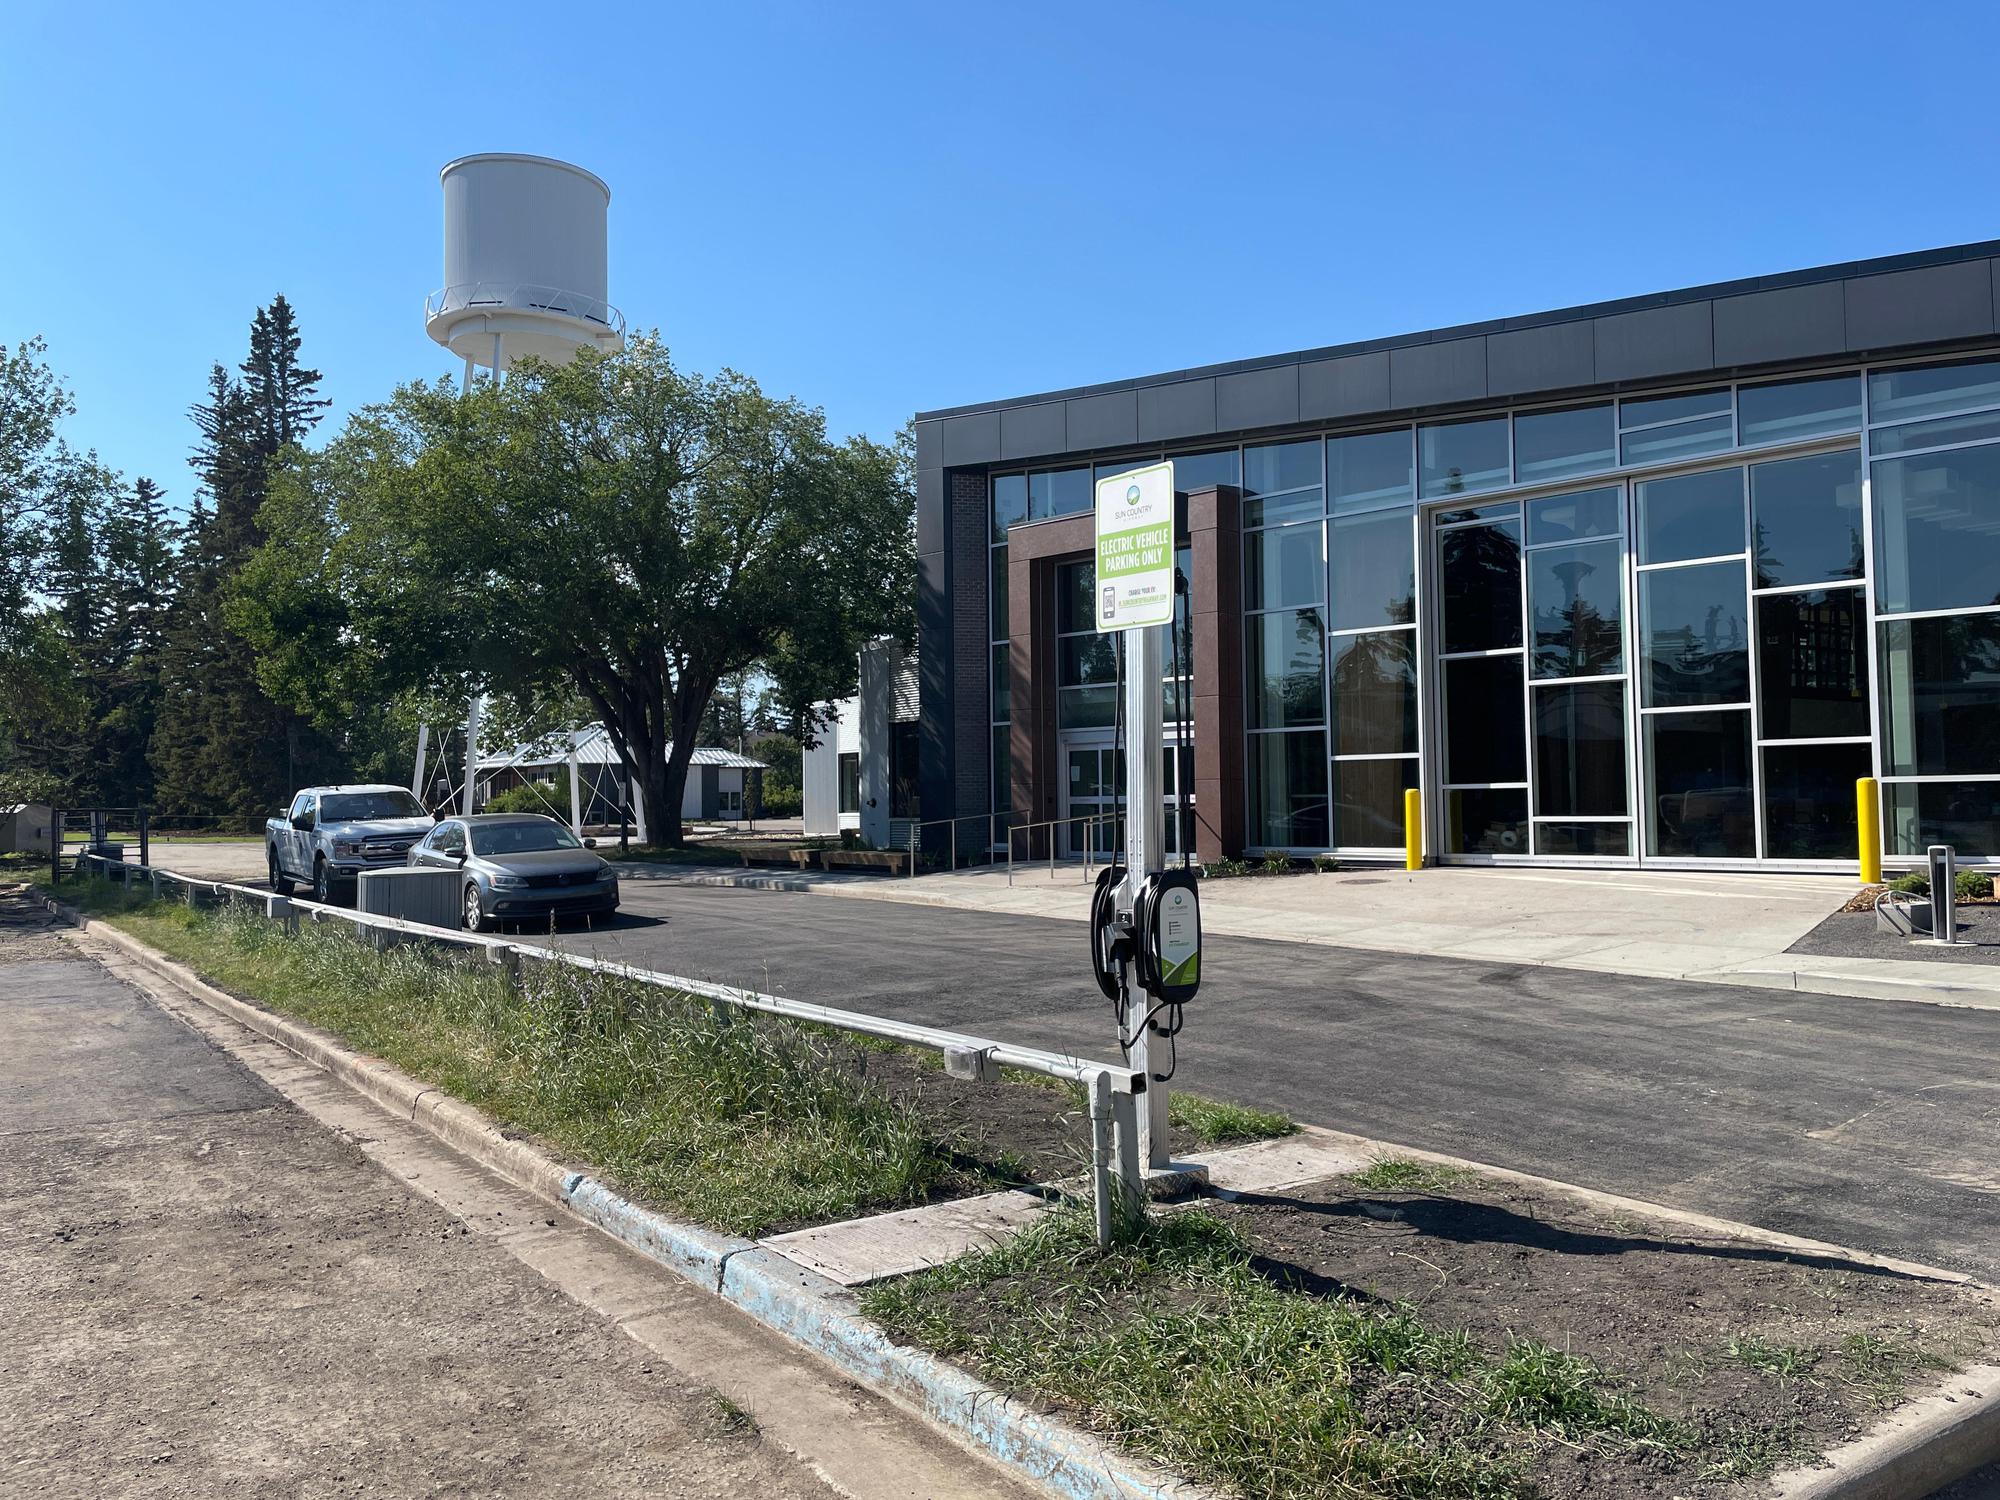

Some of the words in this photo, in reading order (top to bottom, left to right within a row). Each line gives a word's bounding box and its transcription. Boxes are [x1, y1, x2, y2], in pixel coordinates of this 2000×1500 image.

[1127, 504, 1153, 517] COUNTRY
[1100, 535, 1135, 556] ELECTRIC
[1136, 528, 1169, 549] VEHICLE
[1106, 552, 1140, 573] PARKING
[1142, 547, 1163, 566] ONLY
